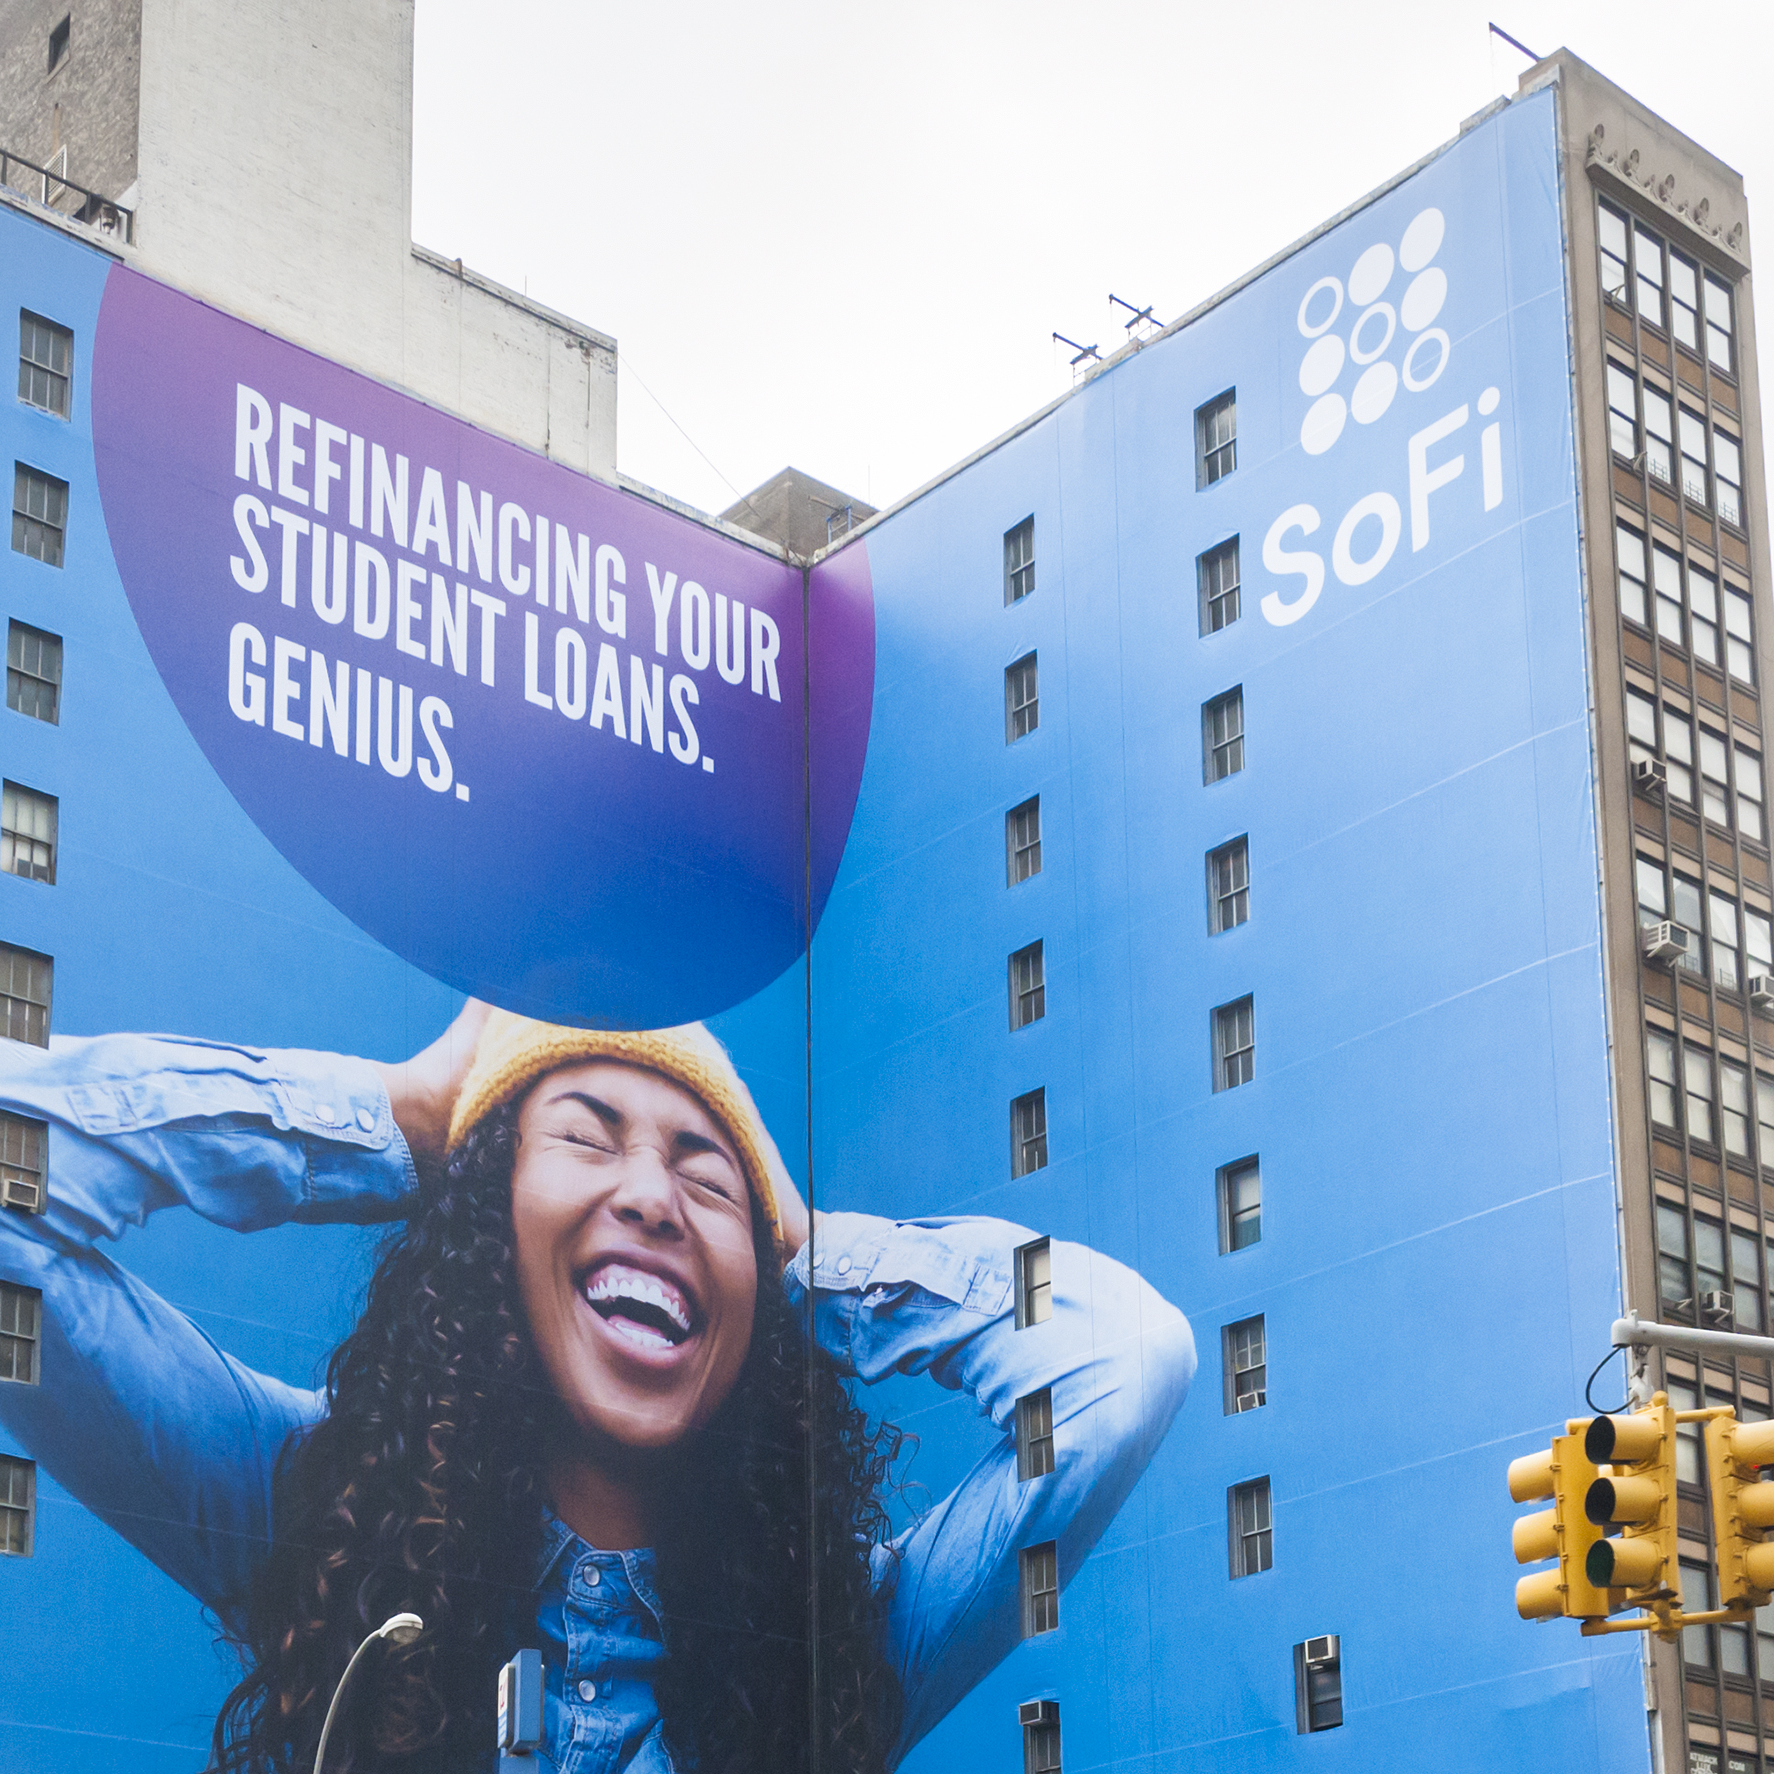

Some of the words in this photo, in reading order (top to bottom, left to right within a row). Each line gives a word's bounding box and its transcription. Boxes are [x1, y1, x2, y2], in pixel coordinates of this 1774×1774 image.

[230, 494, 506, 688] STUDENT
[525, 610, 715, 773] LOANS.
[234, 383, 627, 638] REFINANCING
[645, 562, 782, 702] YOUR
[1260, 386, 1504, 627] SoFi
[228, 622, 470, 802] GENIUS.
